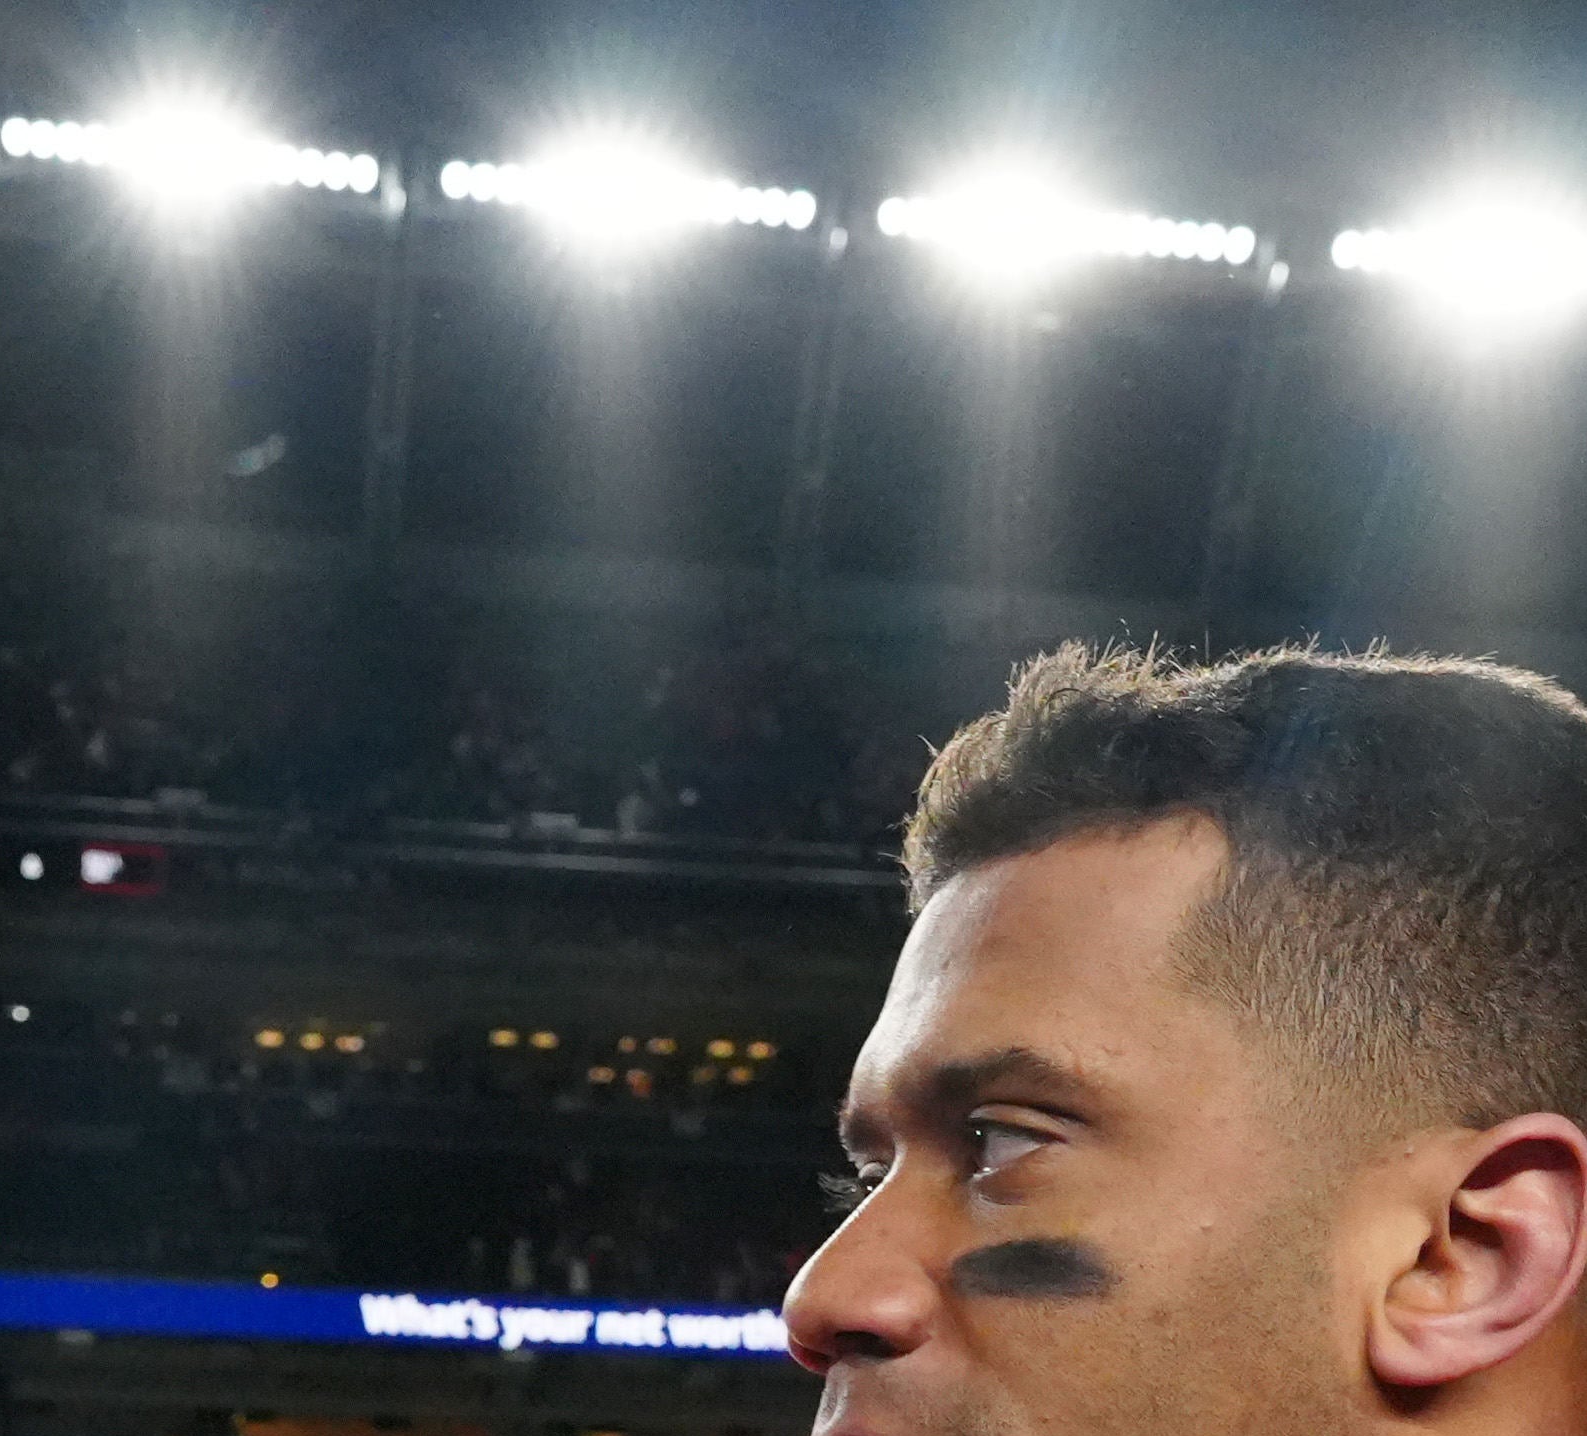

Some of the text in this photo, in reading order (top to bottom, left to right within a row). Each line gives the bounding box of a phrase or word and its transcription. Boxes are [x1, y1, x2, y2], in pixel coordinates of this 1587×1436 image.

[359, 1293, 498, 1340] What's
[499, 1306, 594, 1350] your
[595, 1309, 666, 1347] net
